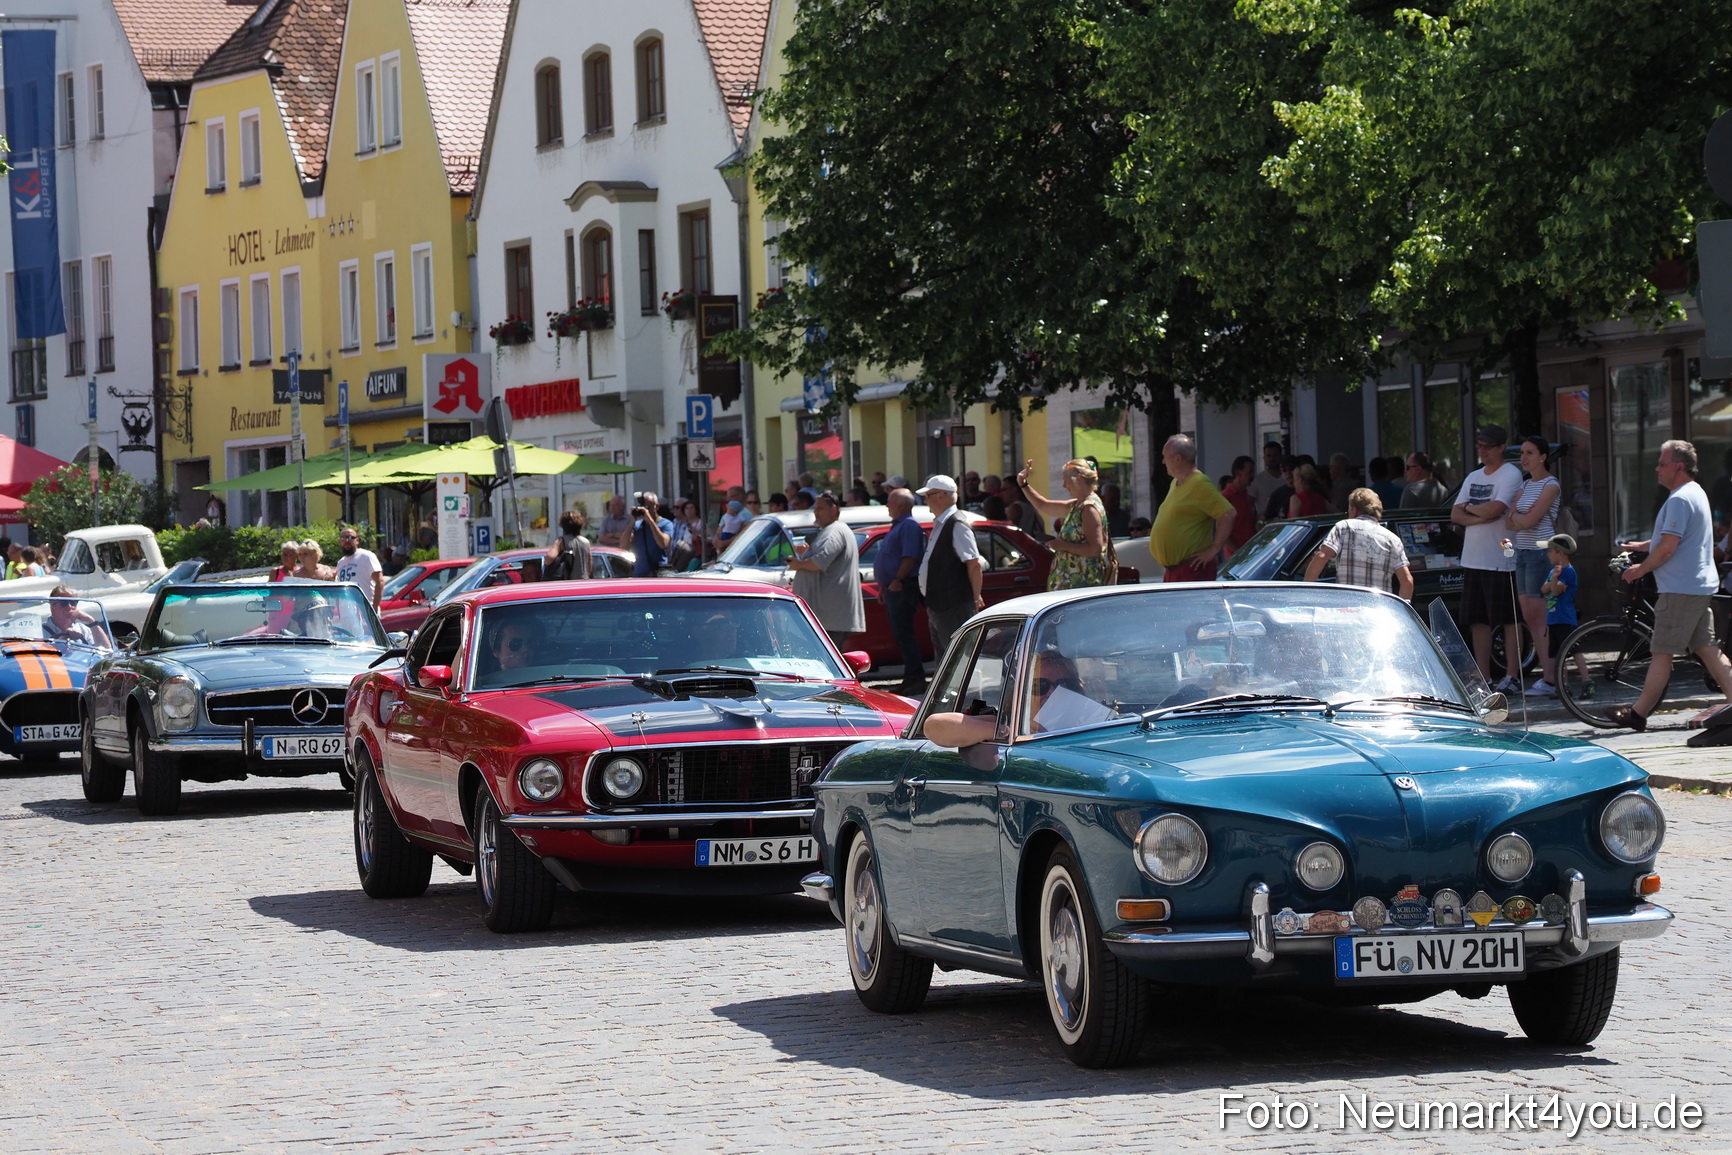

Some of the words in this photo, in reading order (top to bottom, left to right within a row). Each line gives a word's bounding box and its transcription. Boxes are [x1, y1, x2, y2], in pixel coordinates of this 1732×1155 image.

[13, 147, 42, 219] K&L
[40, 147, 52, 219] RUPPERT
[228, 229, 265, 267] HOTEL
[275, 223, 315, 255] Lehmeier
[277, 390, 322, 400] TAFUN
[363, 373, 398, 397] TAIFUN
[230, 406, 282, 431] Restaurant
[691, 401, 707, 433] P
[22, 727, 45, 740] STA
[52, 727, 60, 738] G
[276, 739, 288, 755] N
[298, 739, 319, 754] RQ
[321, 738, 341, 754] 69
[713, 842, 744, 863] NM
[1355, 941, 1396, 973] FÜ
[1416, 938, 1456, 971] NV
[1462, 936, 1520, 969] 20H
